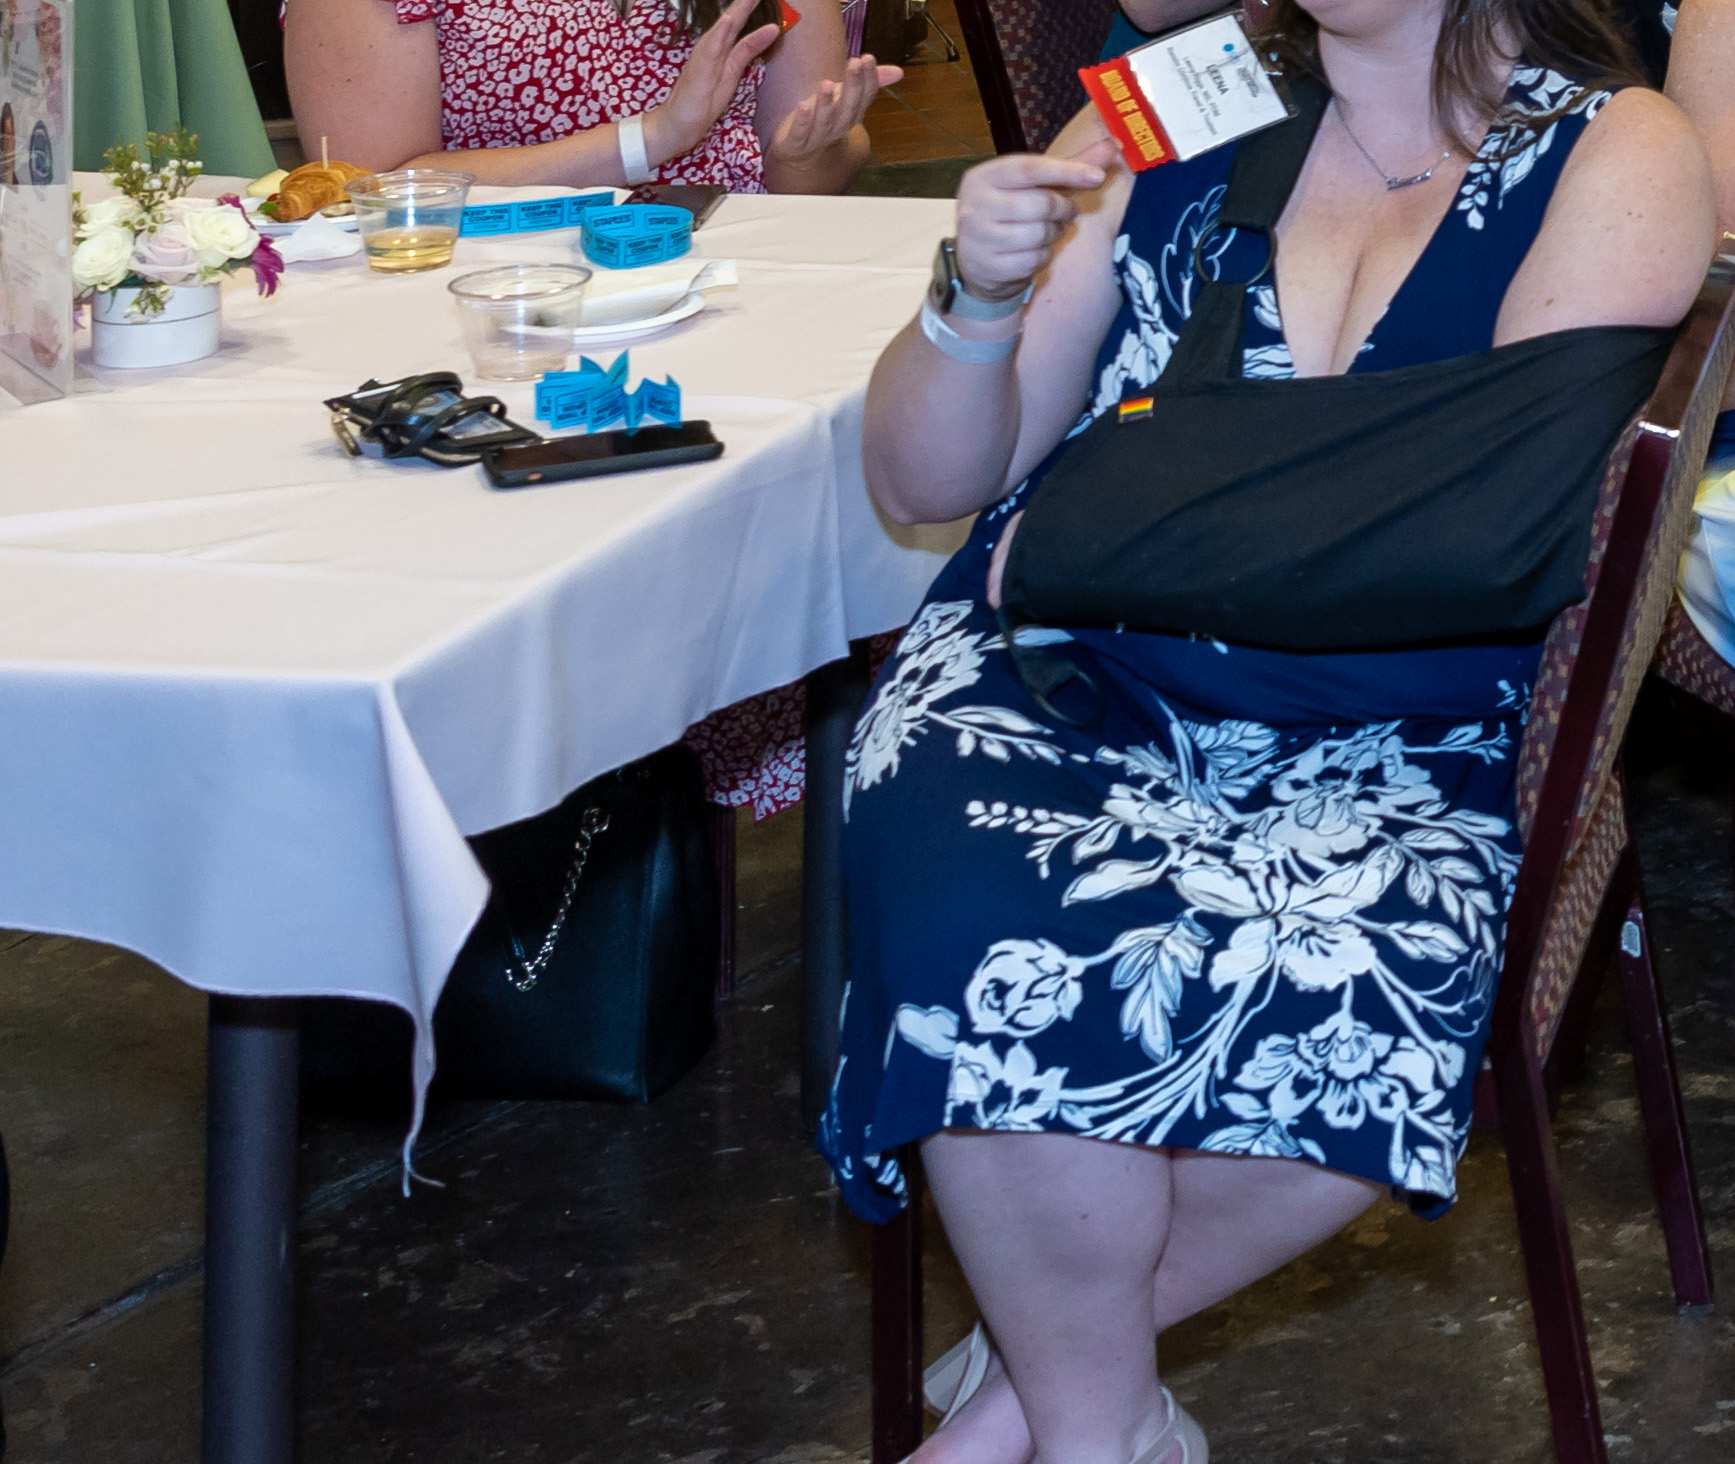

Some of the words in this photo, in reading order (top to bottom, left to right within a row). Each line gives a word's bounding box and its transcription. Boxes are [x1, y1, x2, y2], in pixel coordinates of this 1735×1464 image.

[1099, 69, 1132, 103] BOARD
[1115, 98, 1139, 114] OF
[1123, 111, 1165, 162] DIRECTORS
[521, 204, 542, 212] KEEP
[545, 202, 562, 210] THIS
[468, 214, 504, 223] COUPON
[525, 209, 557, 218] COUPON
[632, 245, 658, 254] COUPON
